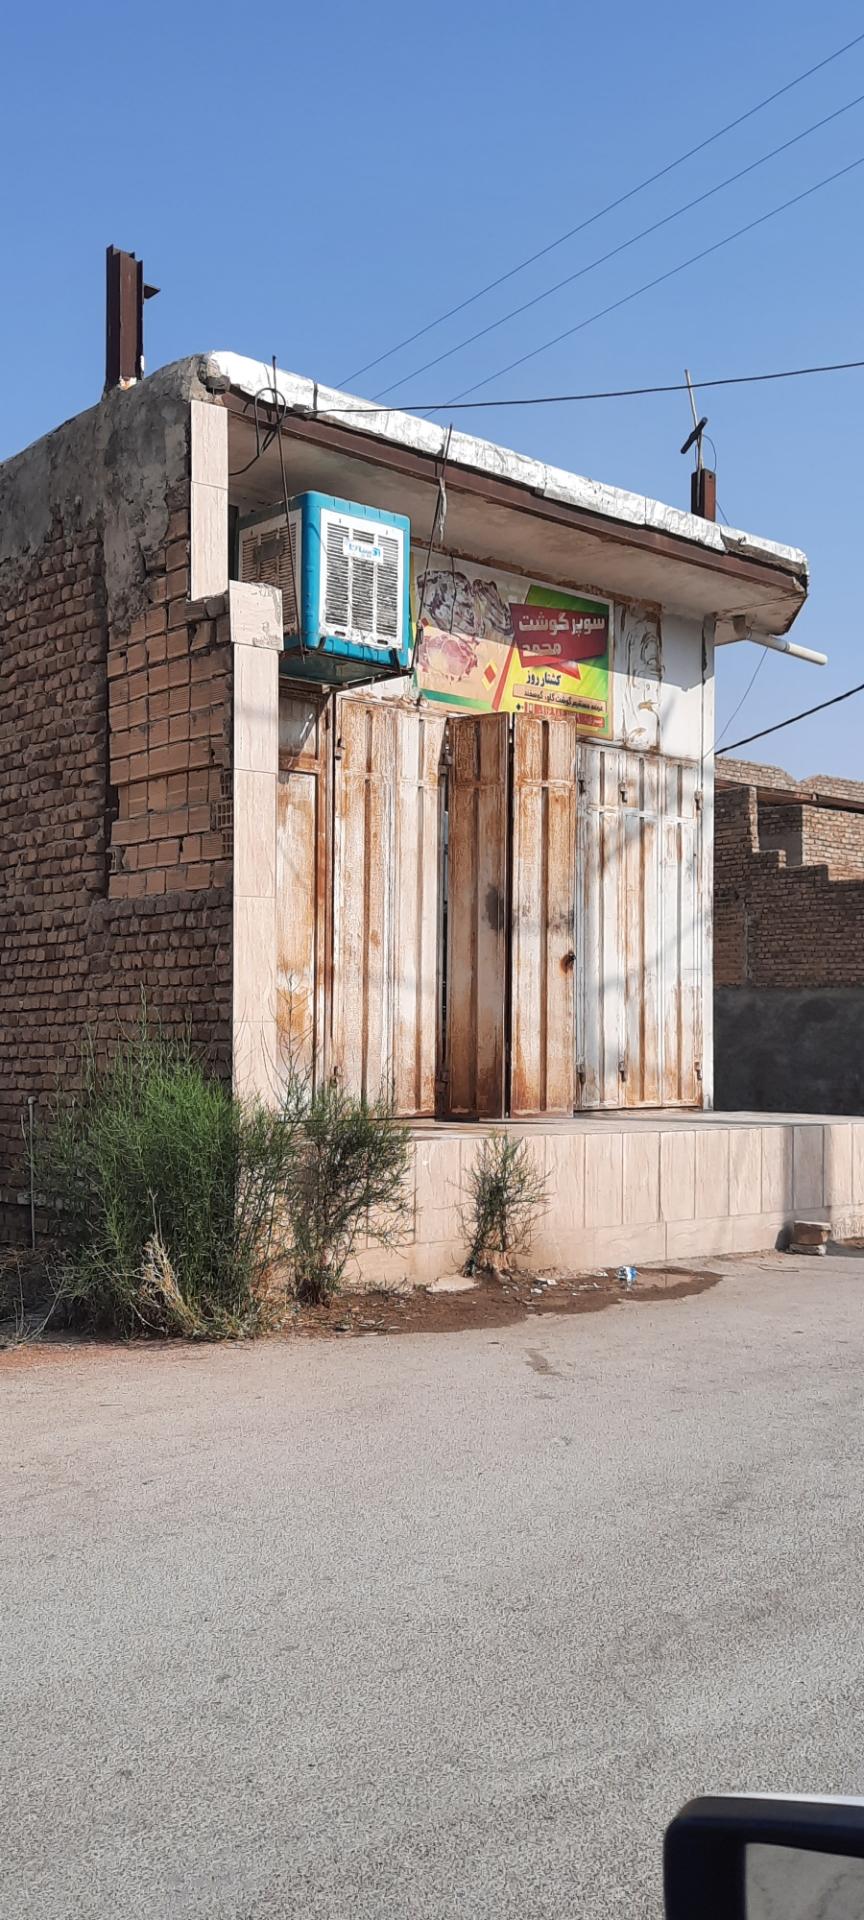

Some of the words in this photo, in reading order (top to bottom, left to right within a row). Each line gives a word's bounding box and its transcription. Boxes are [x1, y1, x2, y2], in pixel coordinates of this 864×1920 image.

[519, 612, 569, 635] گوشت
[572, 617, 605, 636] سوپر
[522, 643, 562, 657] محمد
[527, 670, 540, 686] روز
[541, 672, 561, 687] کشتار
[555, 695, 572, 706] گوشت
